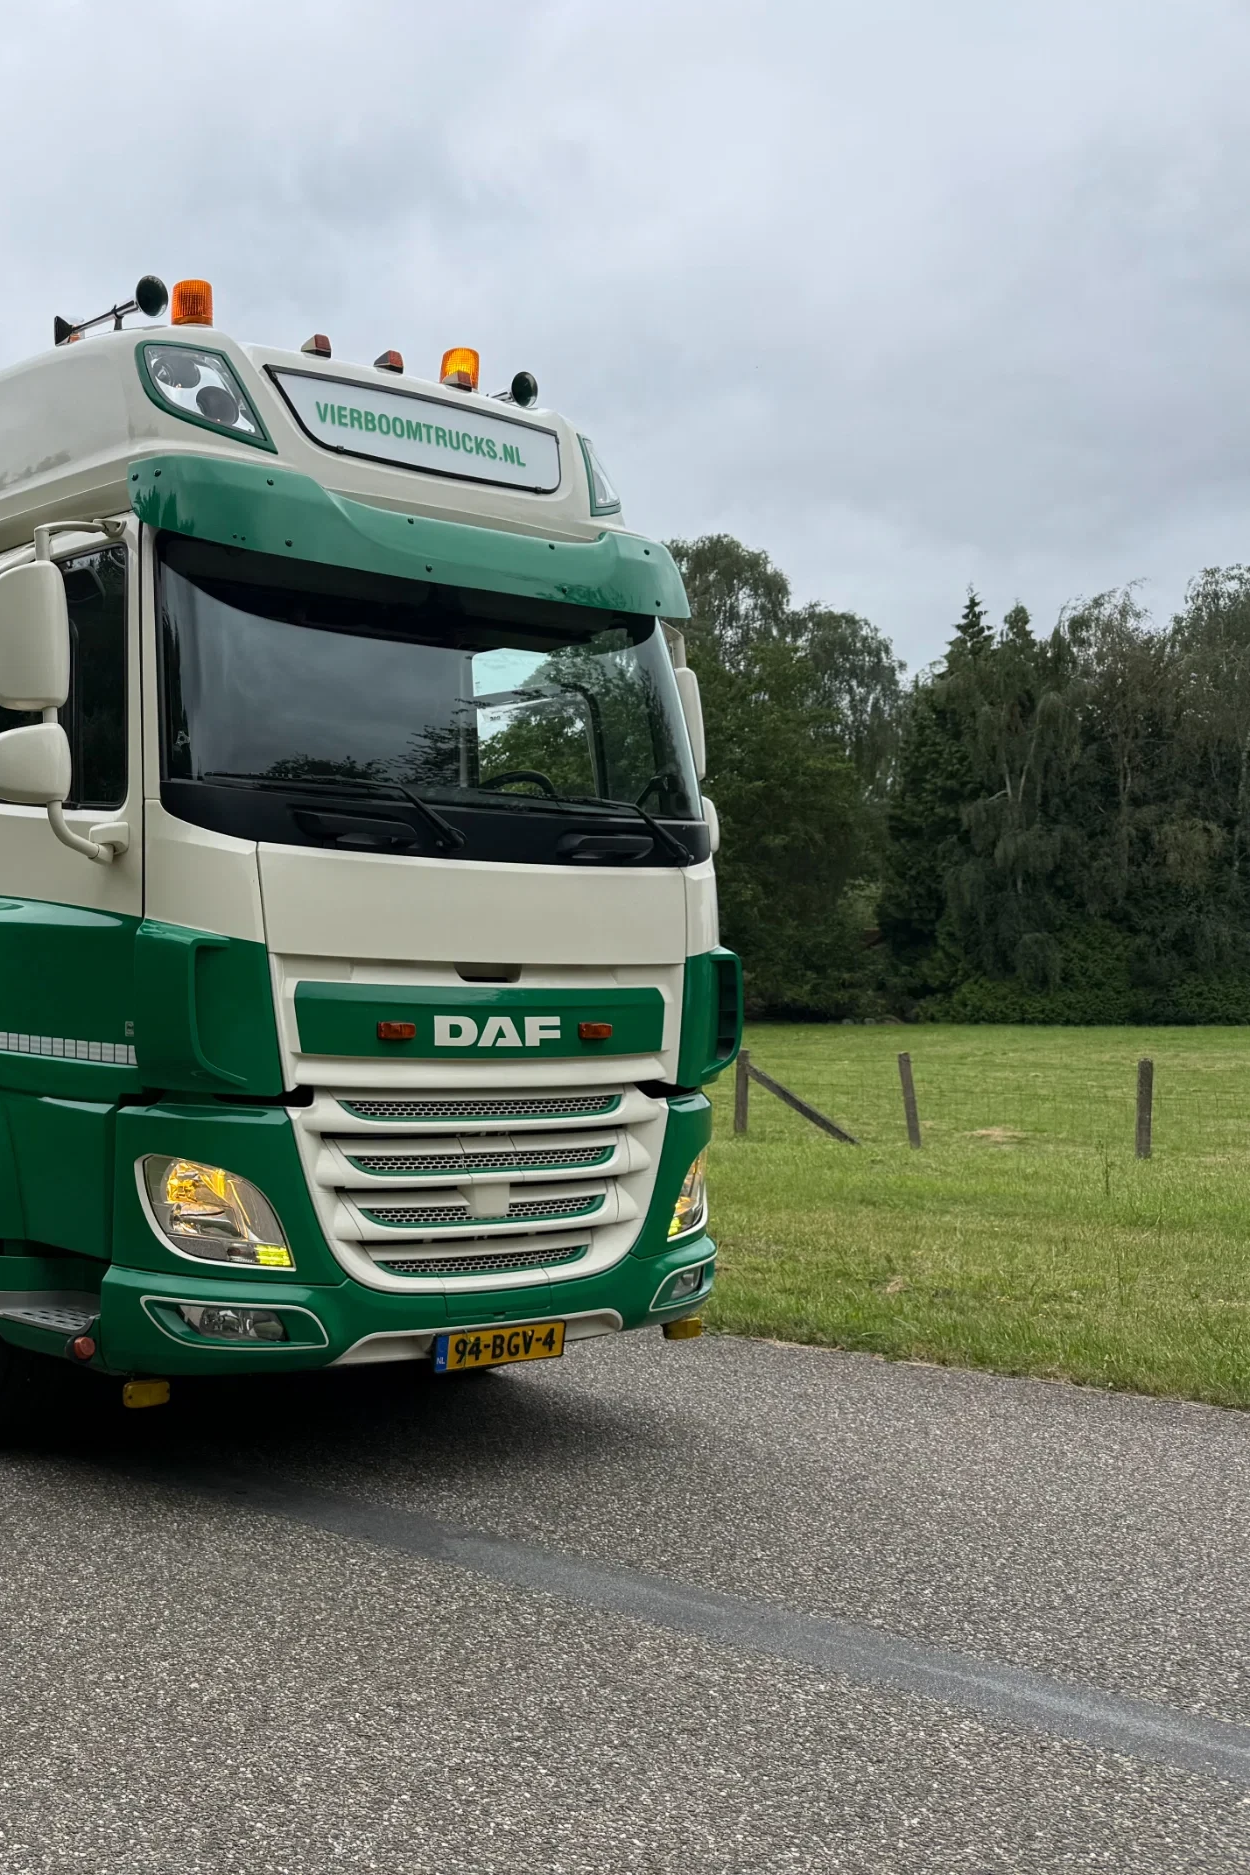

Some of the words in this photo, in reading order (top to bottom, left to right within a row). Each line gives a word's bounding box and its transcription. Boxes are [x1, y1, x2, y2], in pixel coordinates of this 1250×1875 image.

[315, 401, 526, 467] VIERBOOMTRUCKS.NL
[434, 1015, 561, 1047] DAF
[436, 1356, 446, 1365] NL
[454, 1327, 556, 1365] 94-BGV-4
